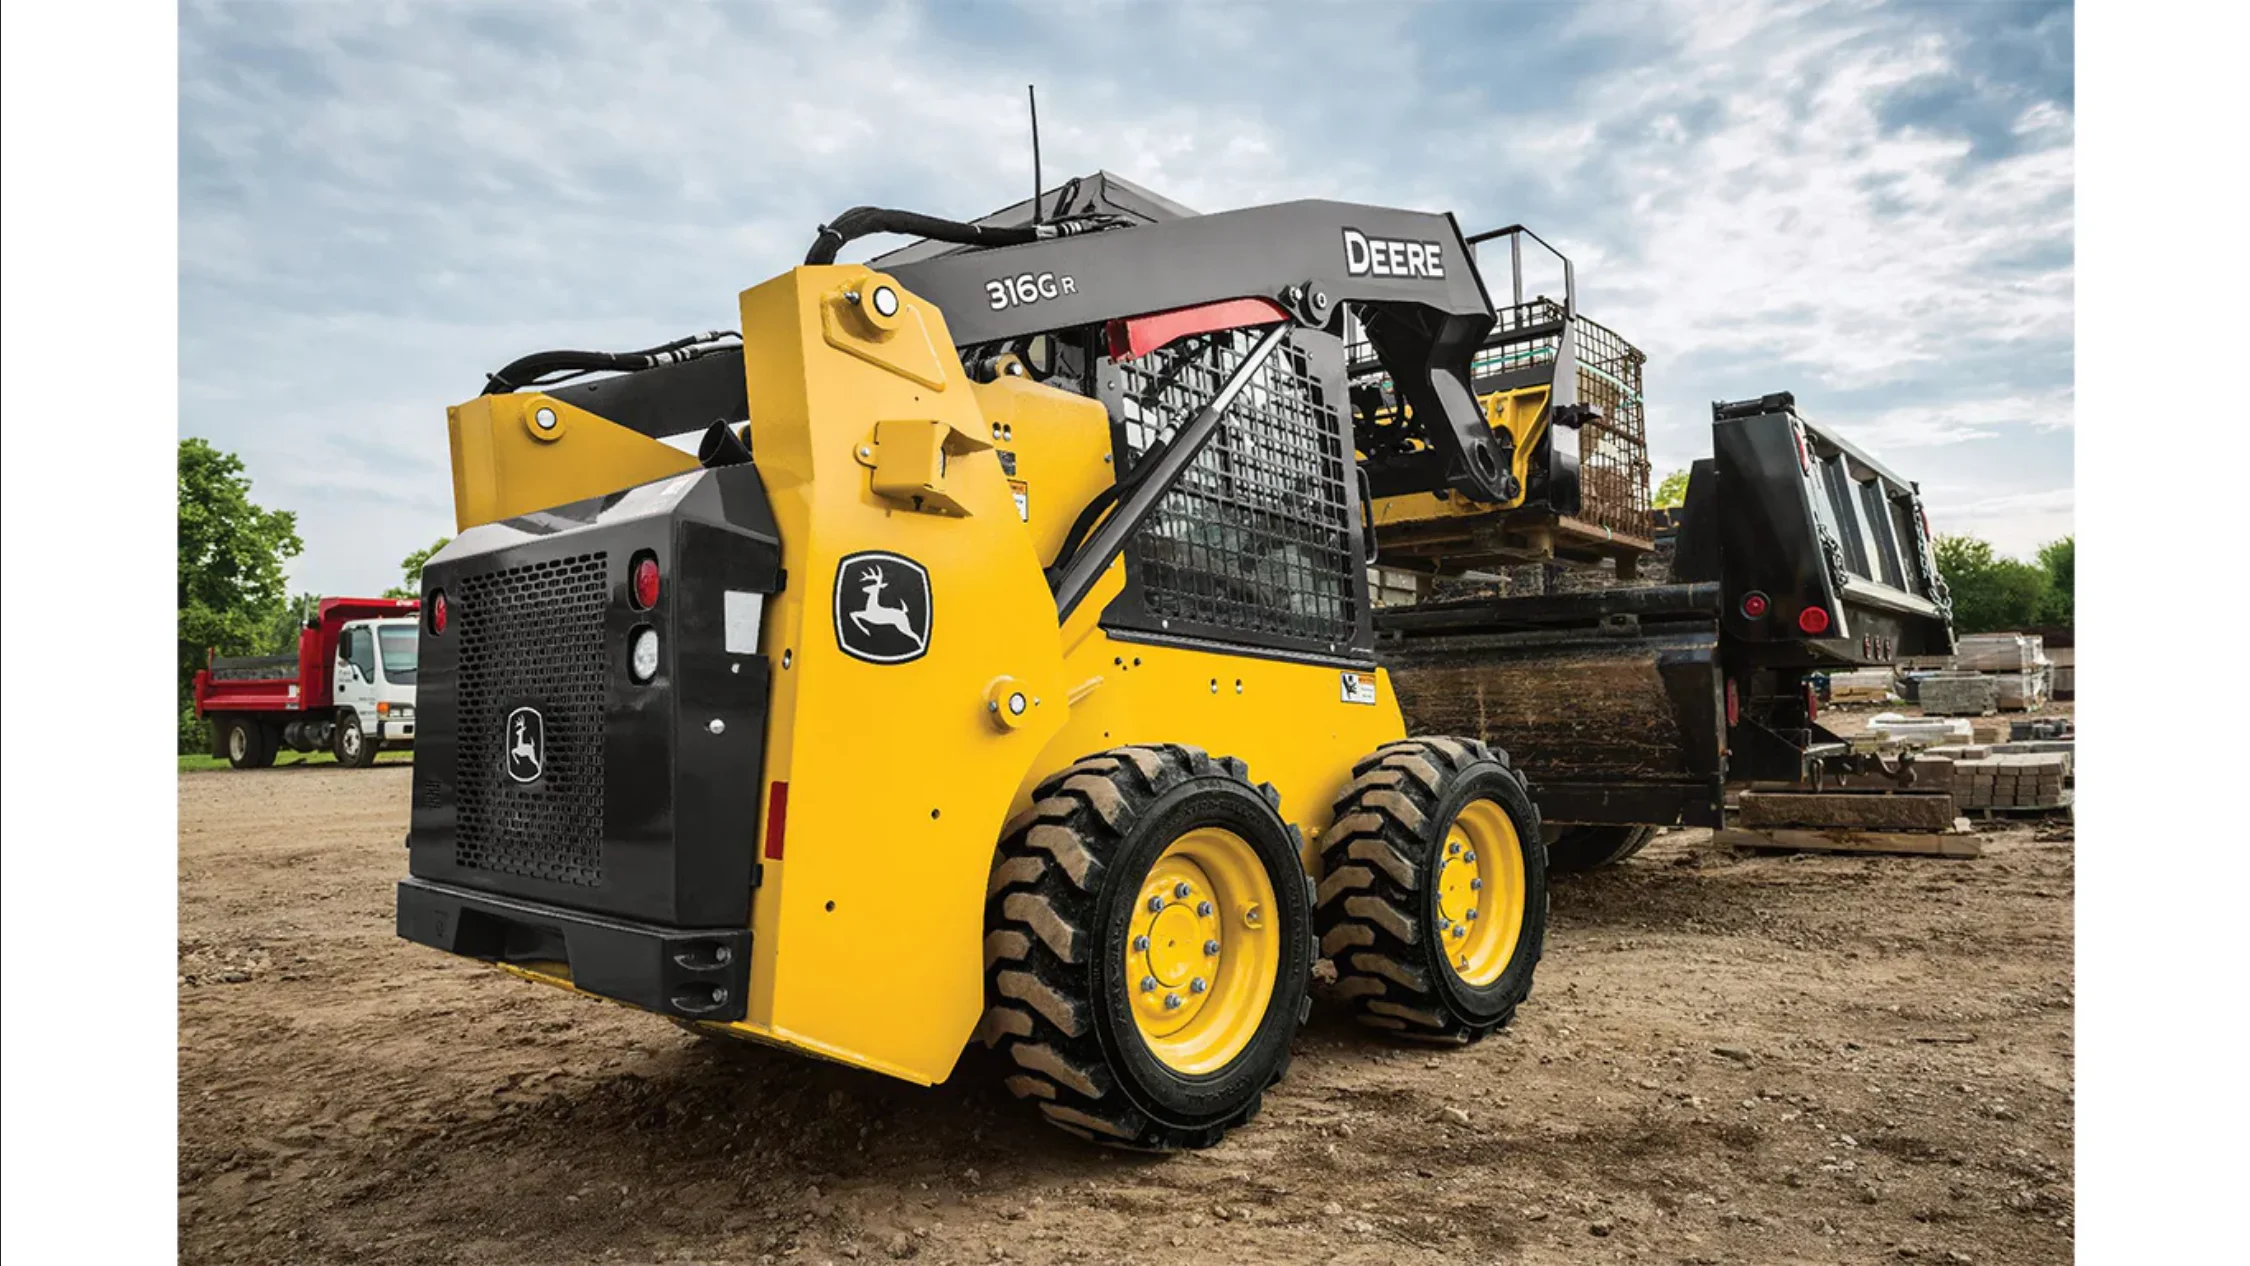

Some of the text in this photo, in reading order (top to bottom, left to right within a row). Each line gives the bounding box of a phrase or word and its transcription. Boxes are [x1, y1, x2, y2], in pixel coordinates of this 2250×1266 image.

[1342, 228, 1445, 278] DEERE
[984, 272, 1077, 310] 316G R
